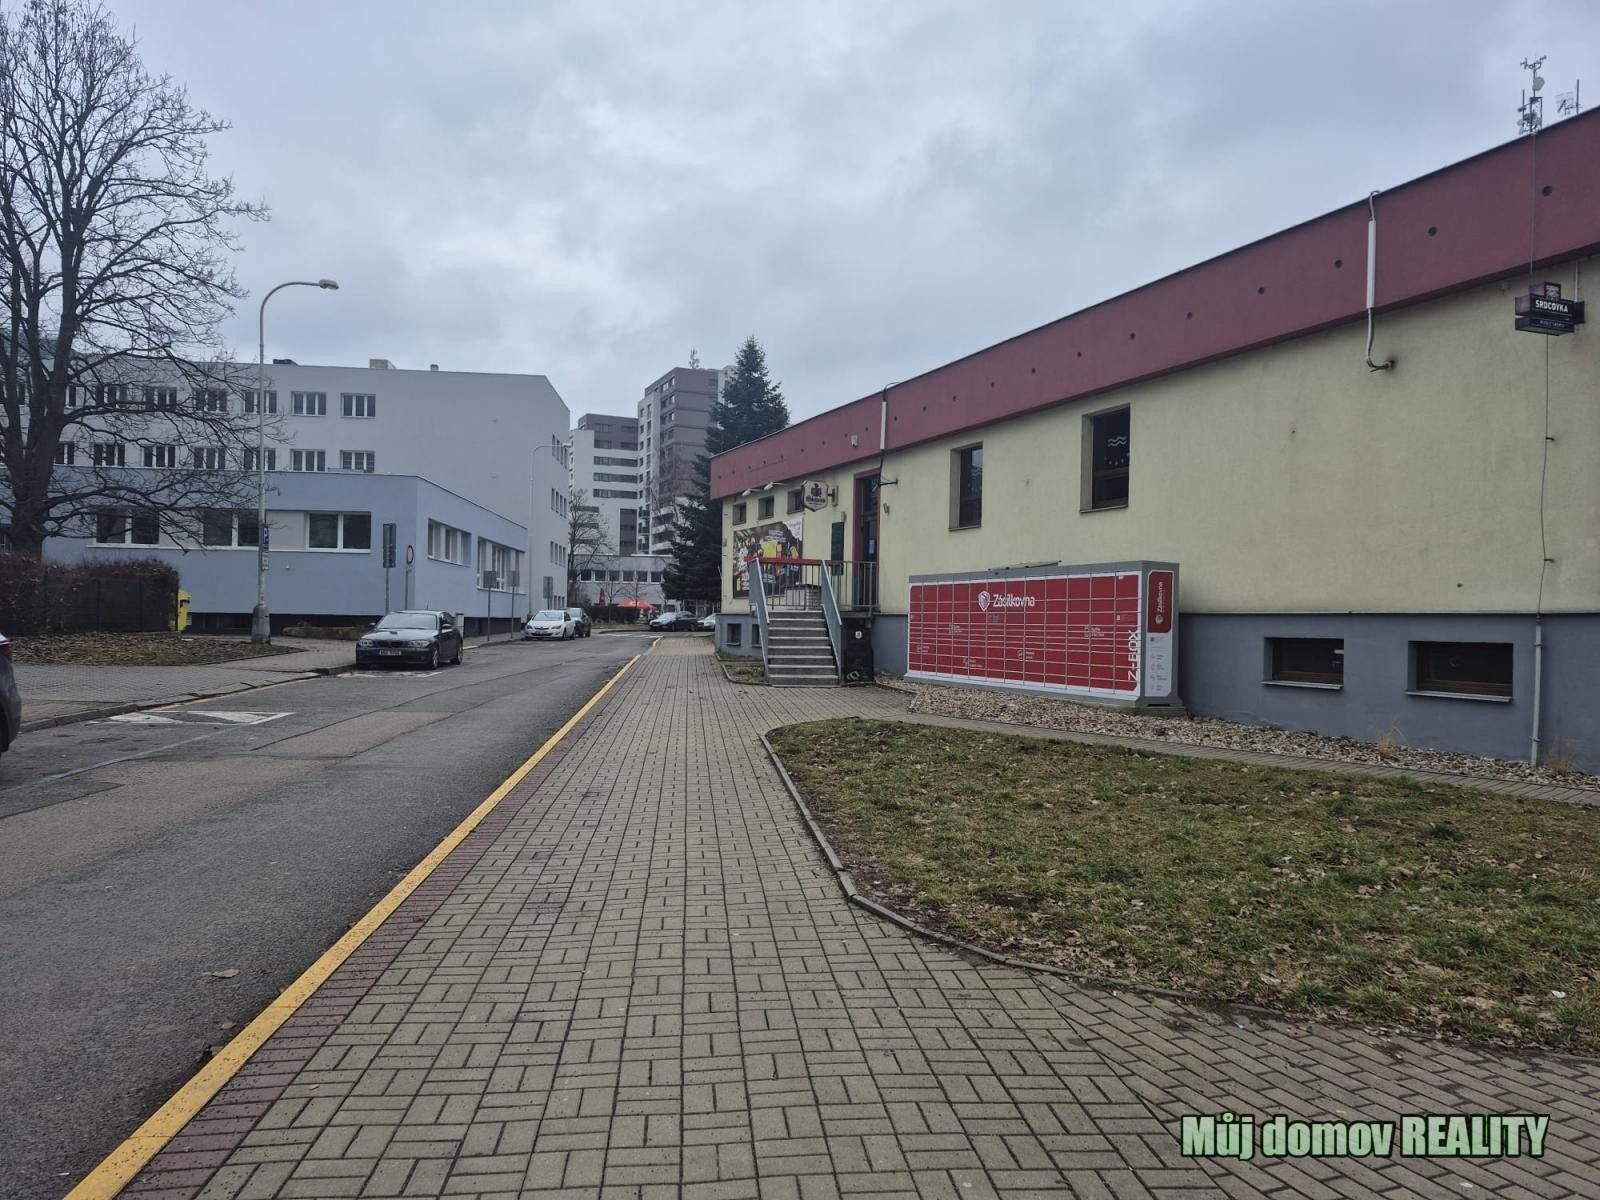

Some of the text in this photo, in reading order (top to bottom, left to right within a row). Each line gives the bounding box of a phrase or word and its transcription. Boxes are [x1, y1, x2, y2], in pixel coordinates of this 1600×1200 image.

[1535, 300, 1568, 312] SRDCOVKA
[992, 593, 1036, 608] Zásilkovna
[1127, 629, 1138, 681] Z-BOX
